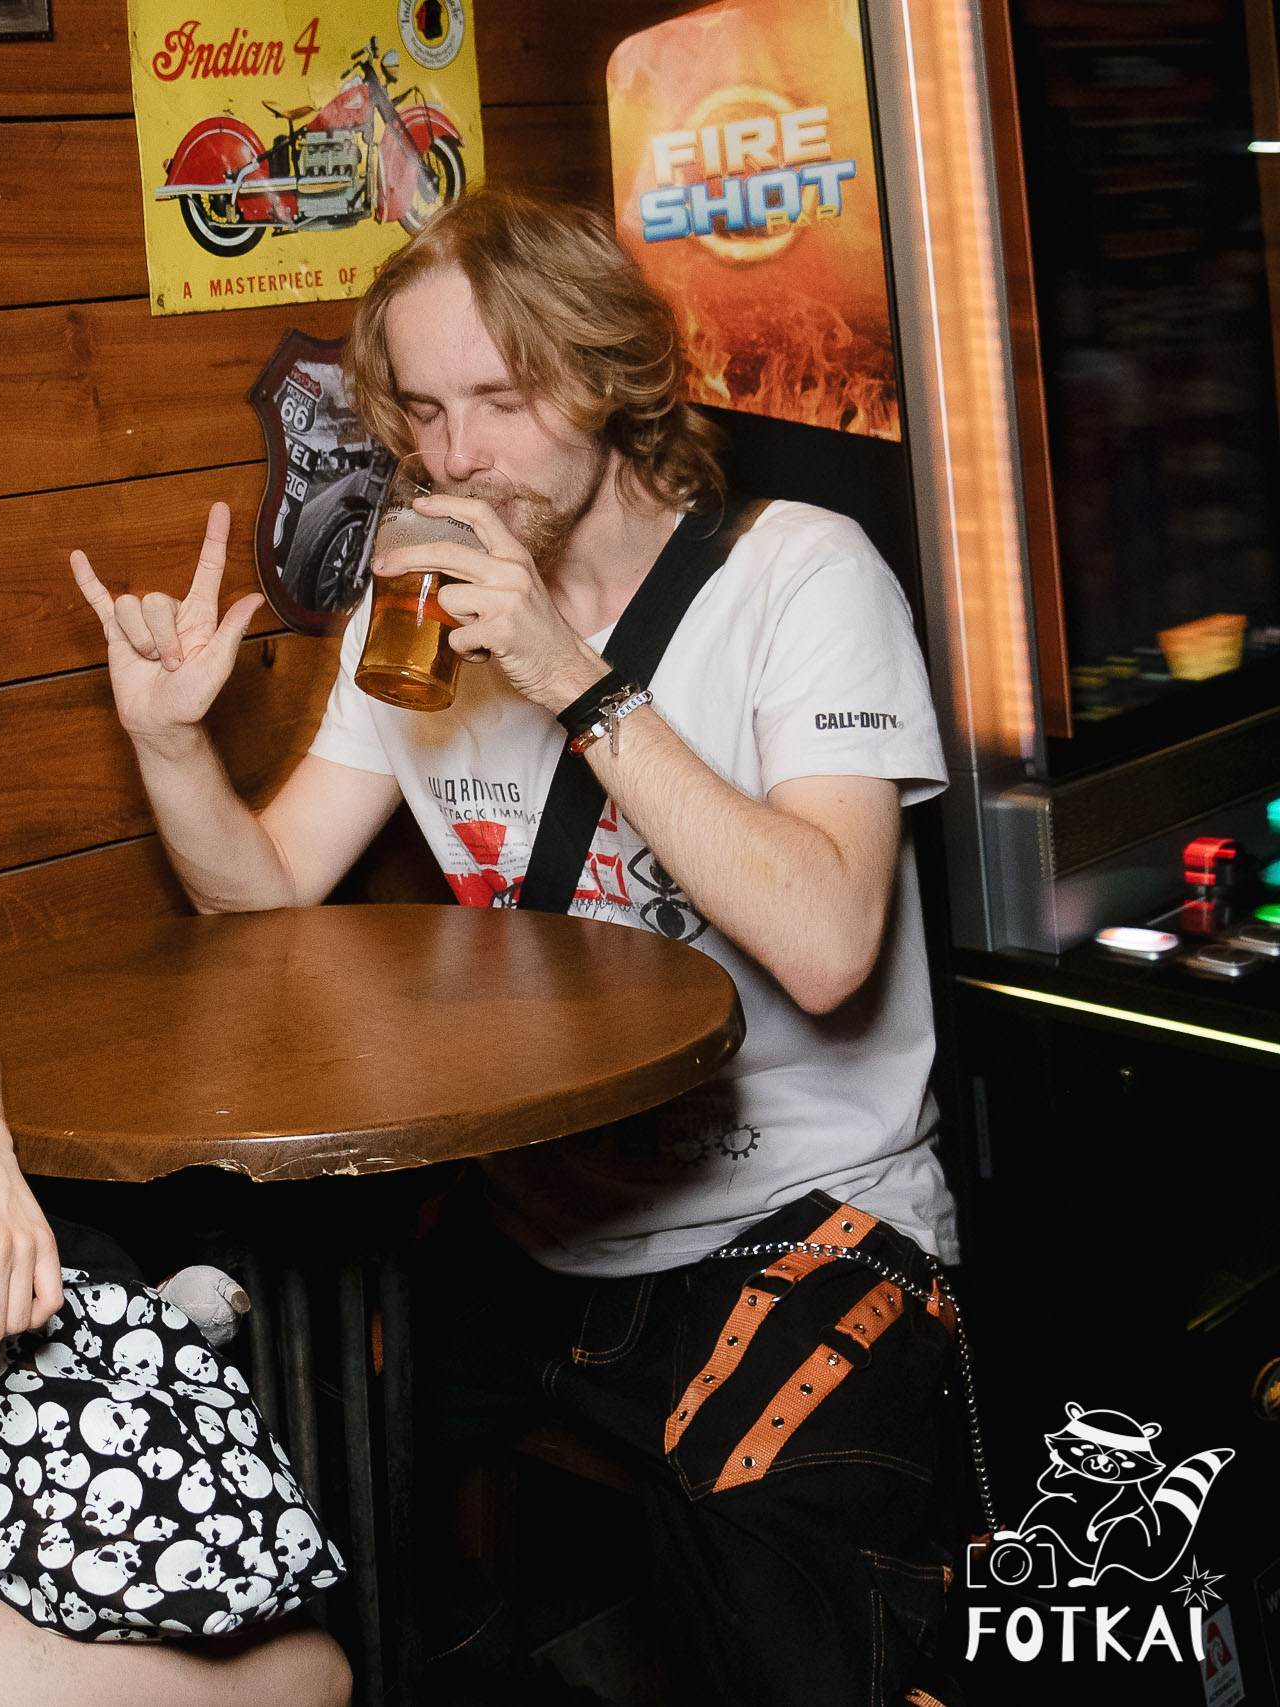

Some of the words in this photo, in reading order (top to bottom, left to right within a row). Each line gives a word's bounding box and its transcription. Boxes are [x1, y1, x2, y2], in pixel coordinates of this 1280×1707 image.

[153, 20, 285, 81] Indian
[293, 17, 320, 76] 4
[651, 105, 832, 188] FIRE
[640, 159, 857, 243] SHOT
[766, 204, 841, 236] BAR
[183, 281, 193, 299] A
[209, 270, 323, 297] MASTERPIECE
[338, 267, 357, 285] OF
[286, 385, 314, 409] ROUTE
[280, 397, 310, 432] 66
[815, 712, 855, 730] CALL
[860, 712, 897, 730] DUTY
